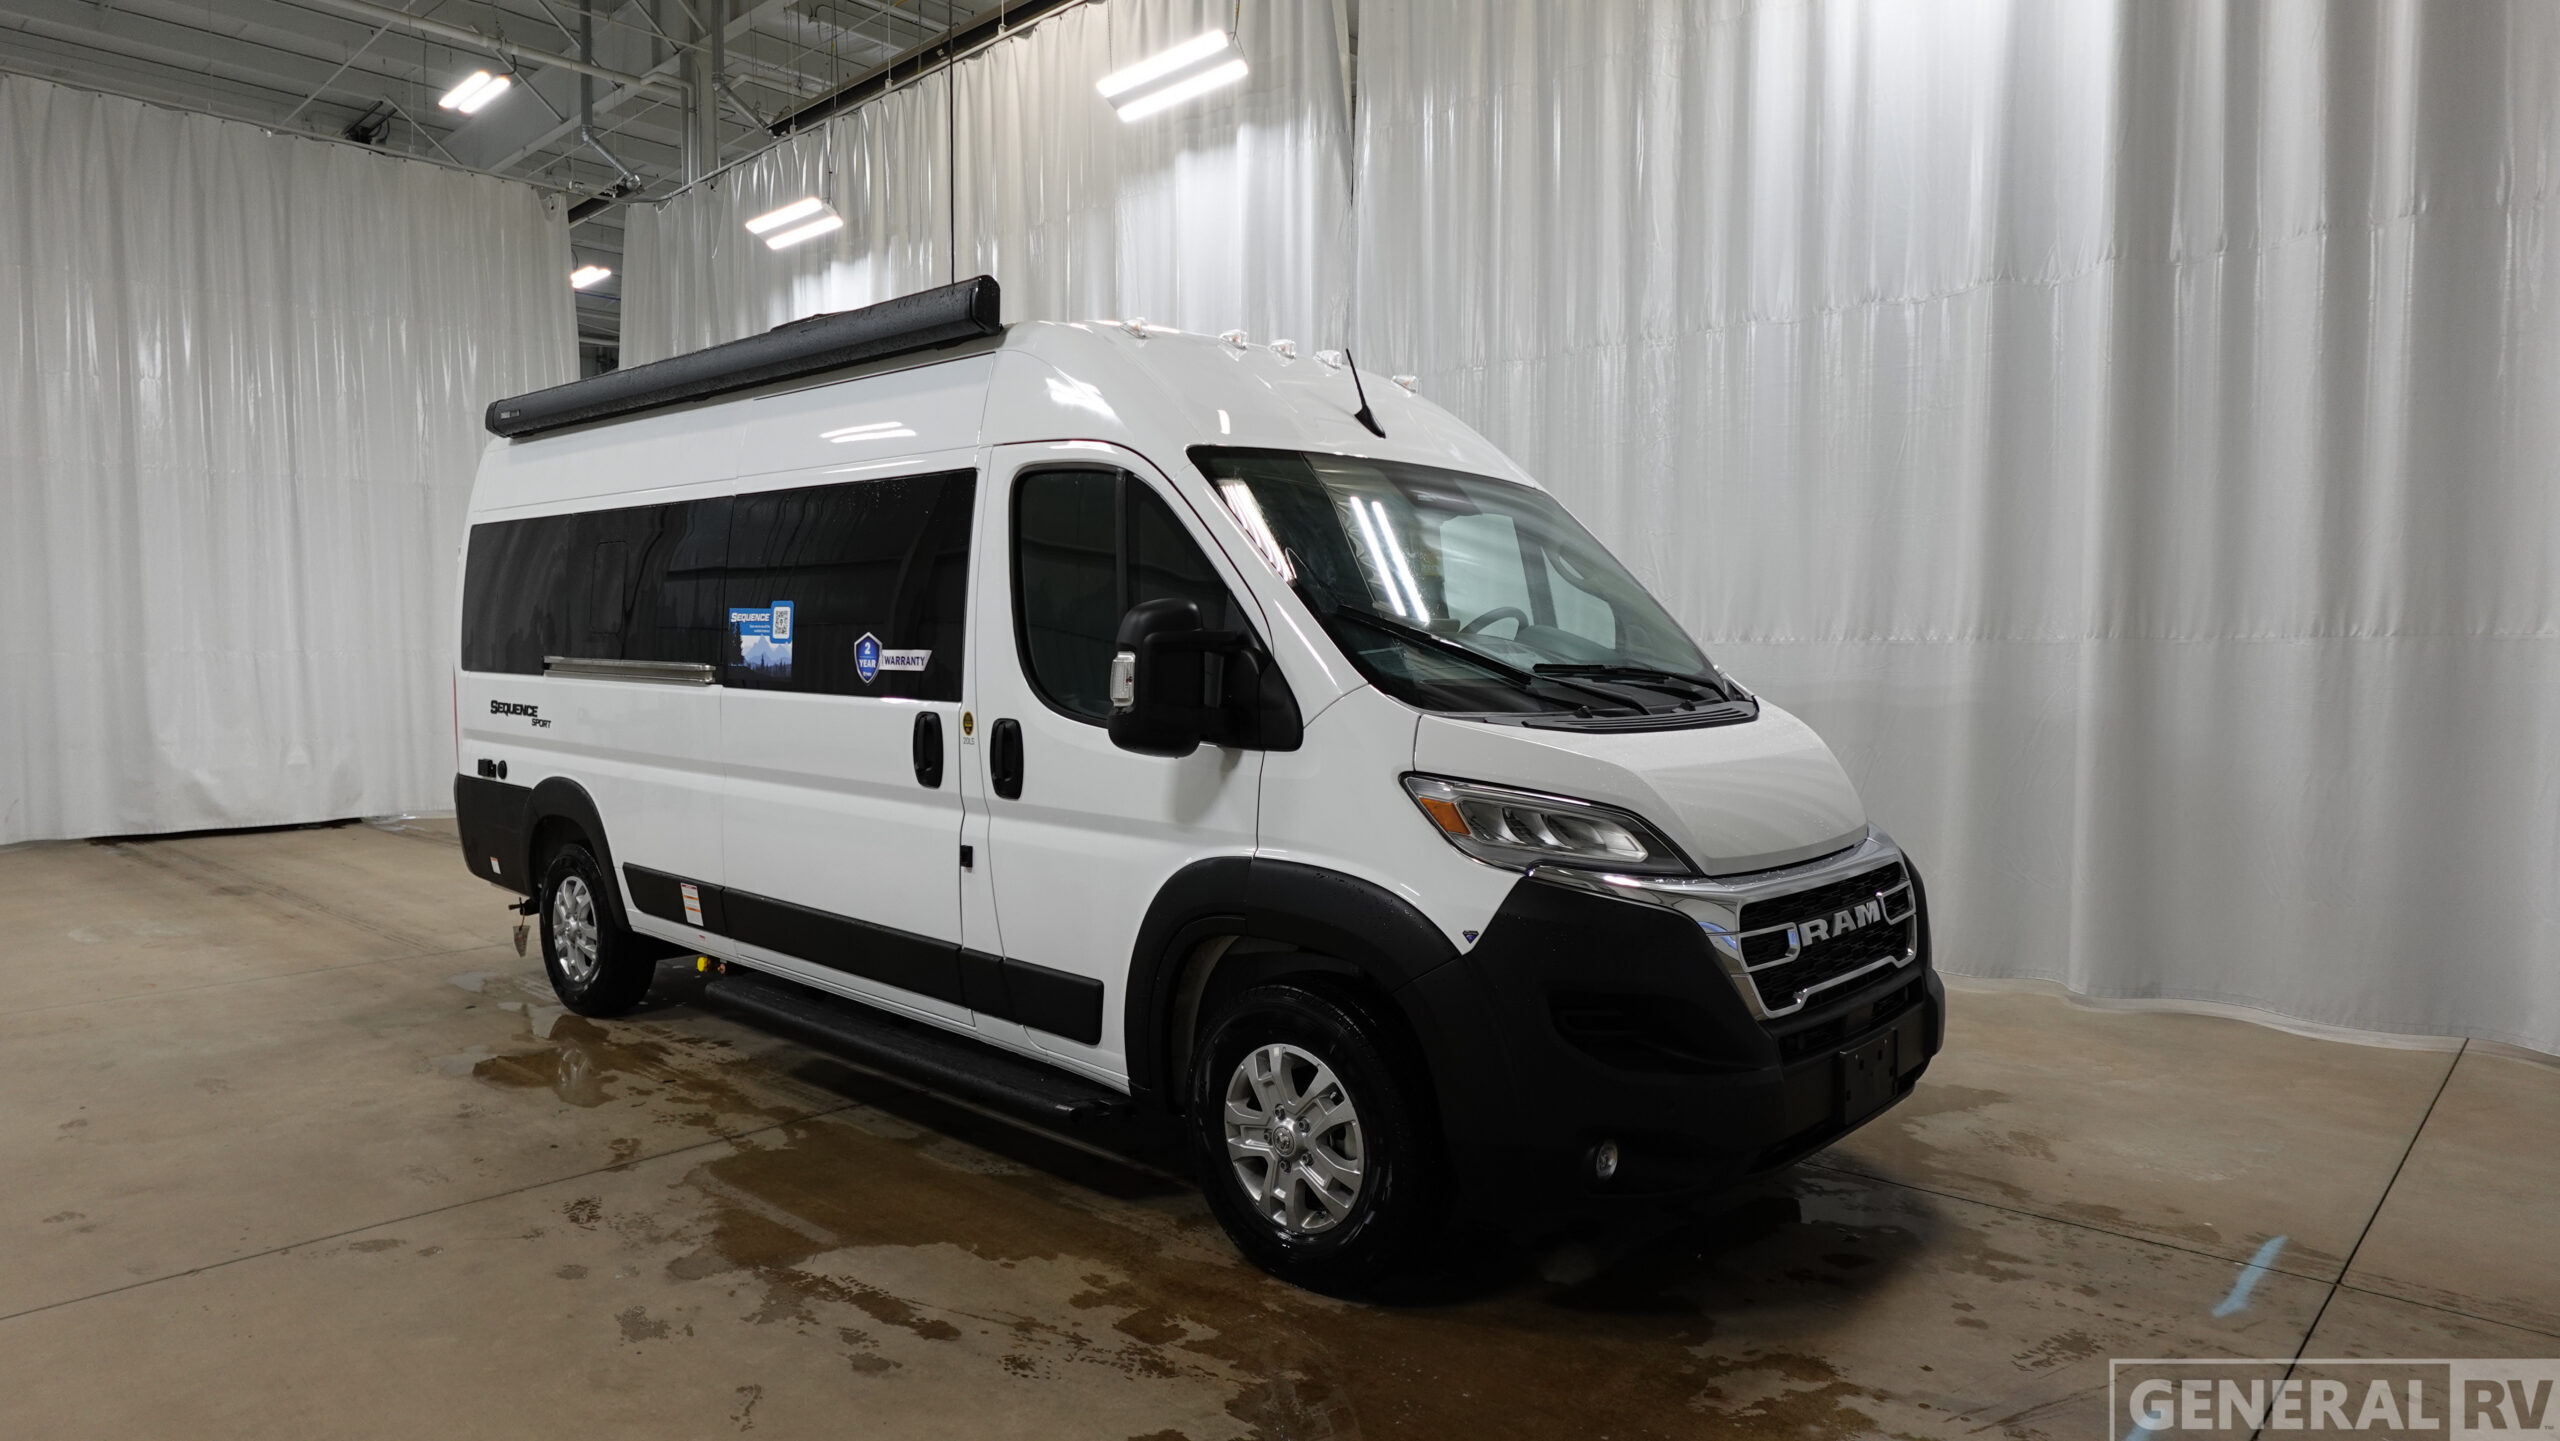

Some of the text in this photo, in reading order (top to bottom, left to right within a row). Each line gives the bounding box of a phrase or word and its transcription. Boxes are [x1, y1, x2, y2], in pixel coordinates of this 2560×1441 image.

[731, 612, 771, 623] SEQUENCE
[864, 642, 871, 655] 2
[859, 659, 876, 668] YEAR
[884, 655, 925, 666] WARRANTY
[490, 700, 538, 717] SEQUENCE
[532, 718, 551, 728] SPORT
[1800, 901, 1881, 946] RAM
